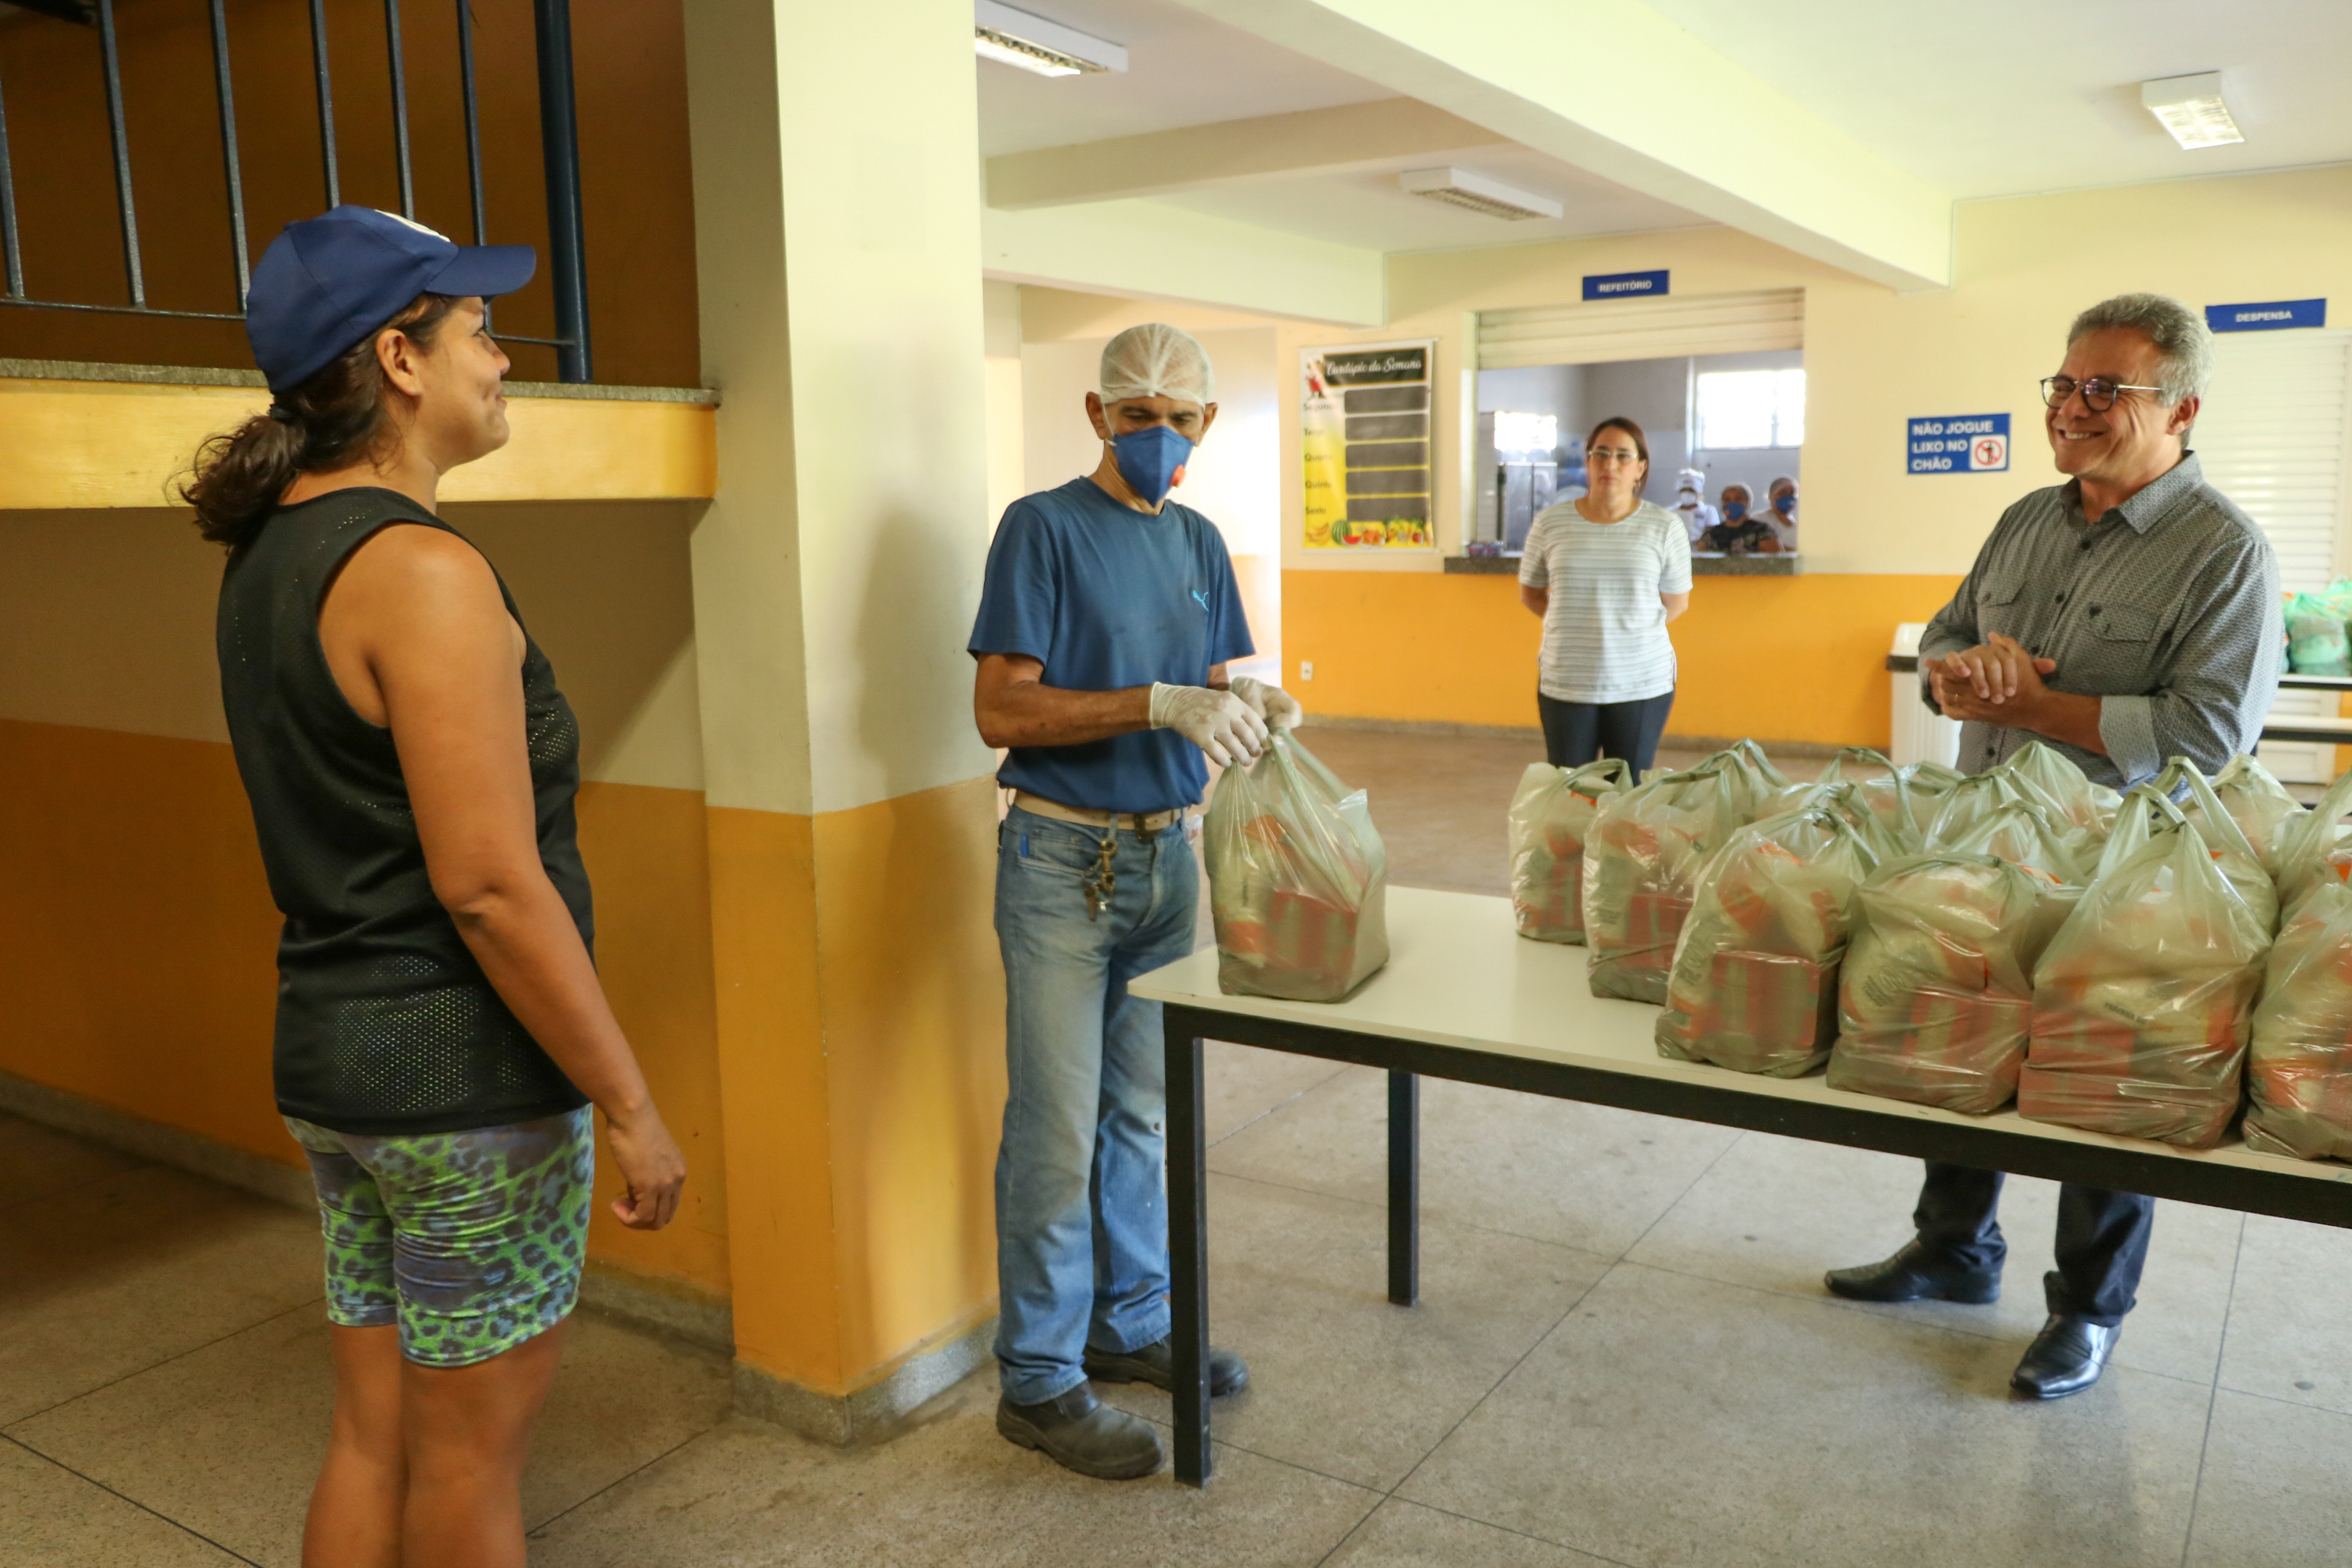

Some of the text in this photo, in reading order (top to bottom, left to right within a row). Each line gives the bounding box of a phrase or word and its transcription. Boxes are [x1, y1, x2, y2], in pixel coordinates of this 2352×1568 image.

[1599, 280, 1652, 292] REFEITÓRIO
[2236, 311, 2293, 322] DESPENSA
[1369, 360, 1381, 371] da
[1383, 356, 1422, 373] Semana
[1913, 420, 1993, 435] NÃO JOGUE
[1913, 439, 1968, 453] LIXO NO
[1913, 456, 1952, 471] CHÃO
